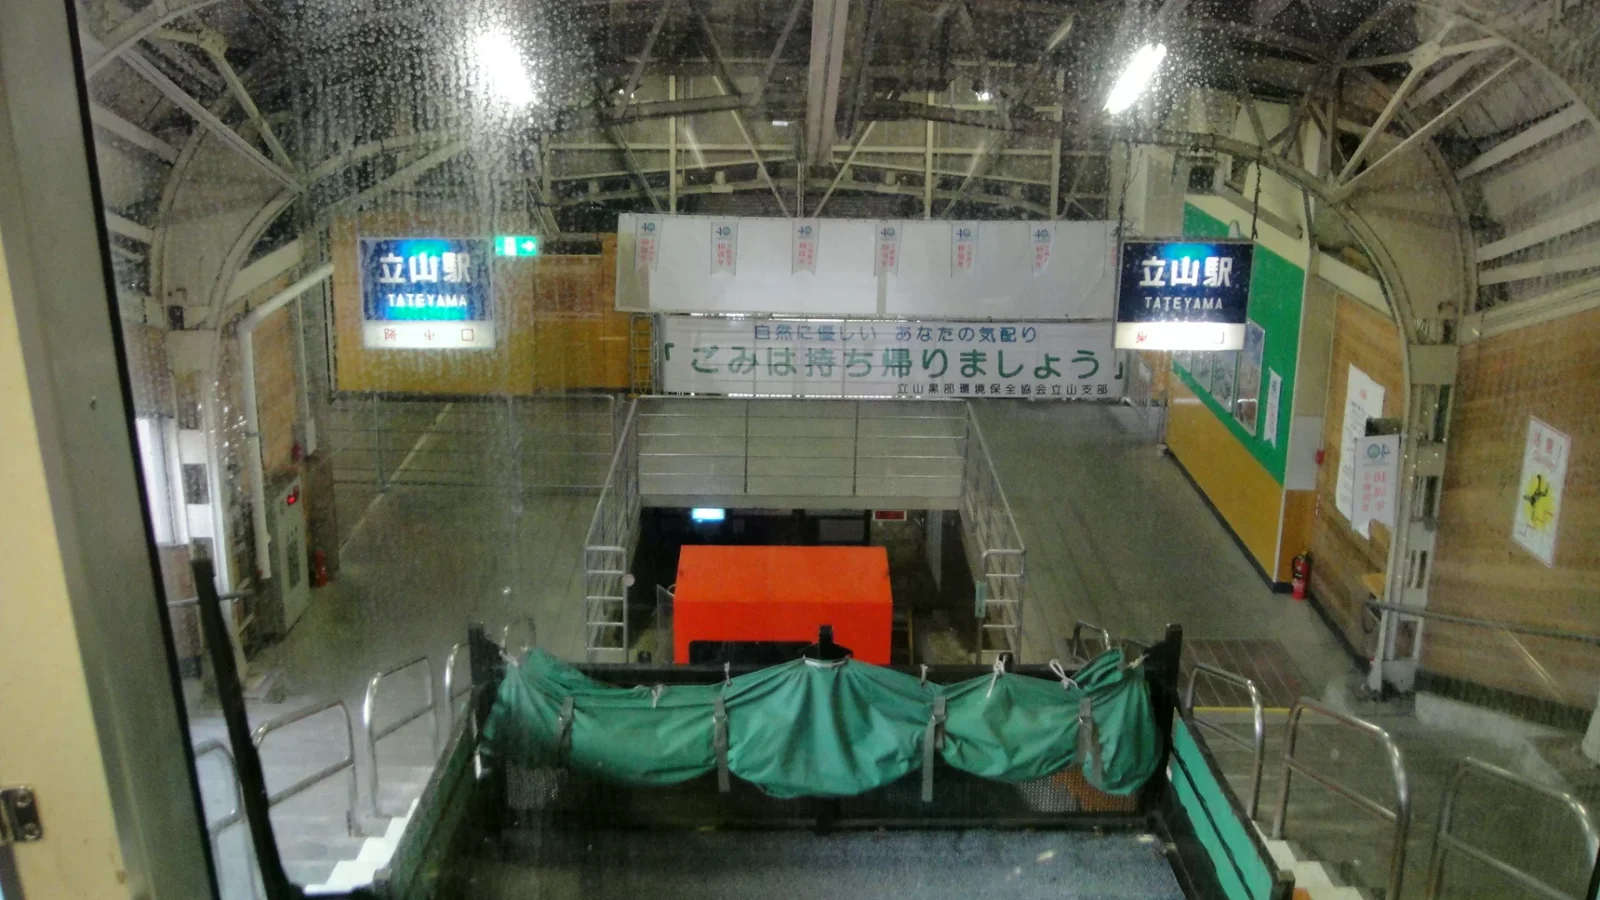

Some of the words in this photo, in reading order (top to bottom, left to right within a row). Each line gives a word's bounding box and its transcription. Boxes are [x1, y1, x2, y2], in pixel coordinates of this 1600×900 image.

[379, 252, 472, 284] 立山駅
[1139, 256, 1233, 287] 立山駅
[388, 293, 467, 308] TATEYAMA
[1145, 296, 1223, 310] TATEYAMA
[754, 324, 876, 342] 自然に優しい
[895, 326, 1037, 343] あなたの気配り
[897, 383, 1108, 396] 立山黒部環境保全協会立山支部
